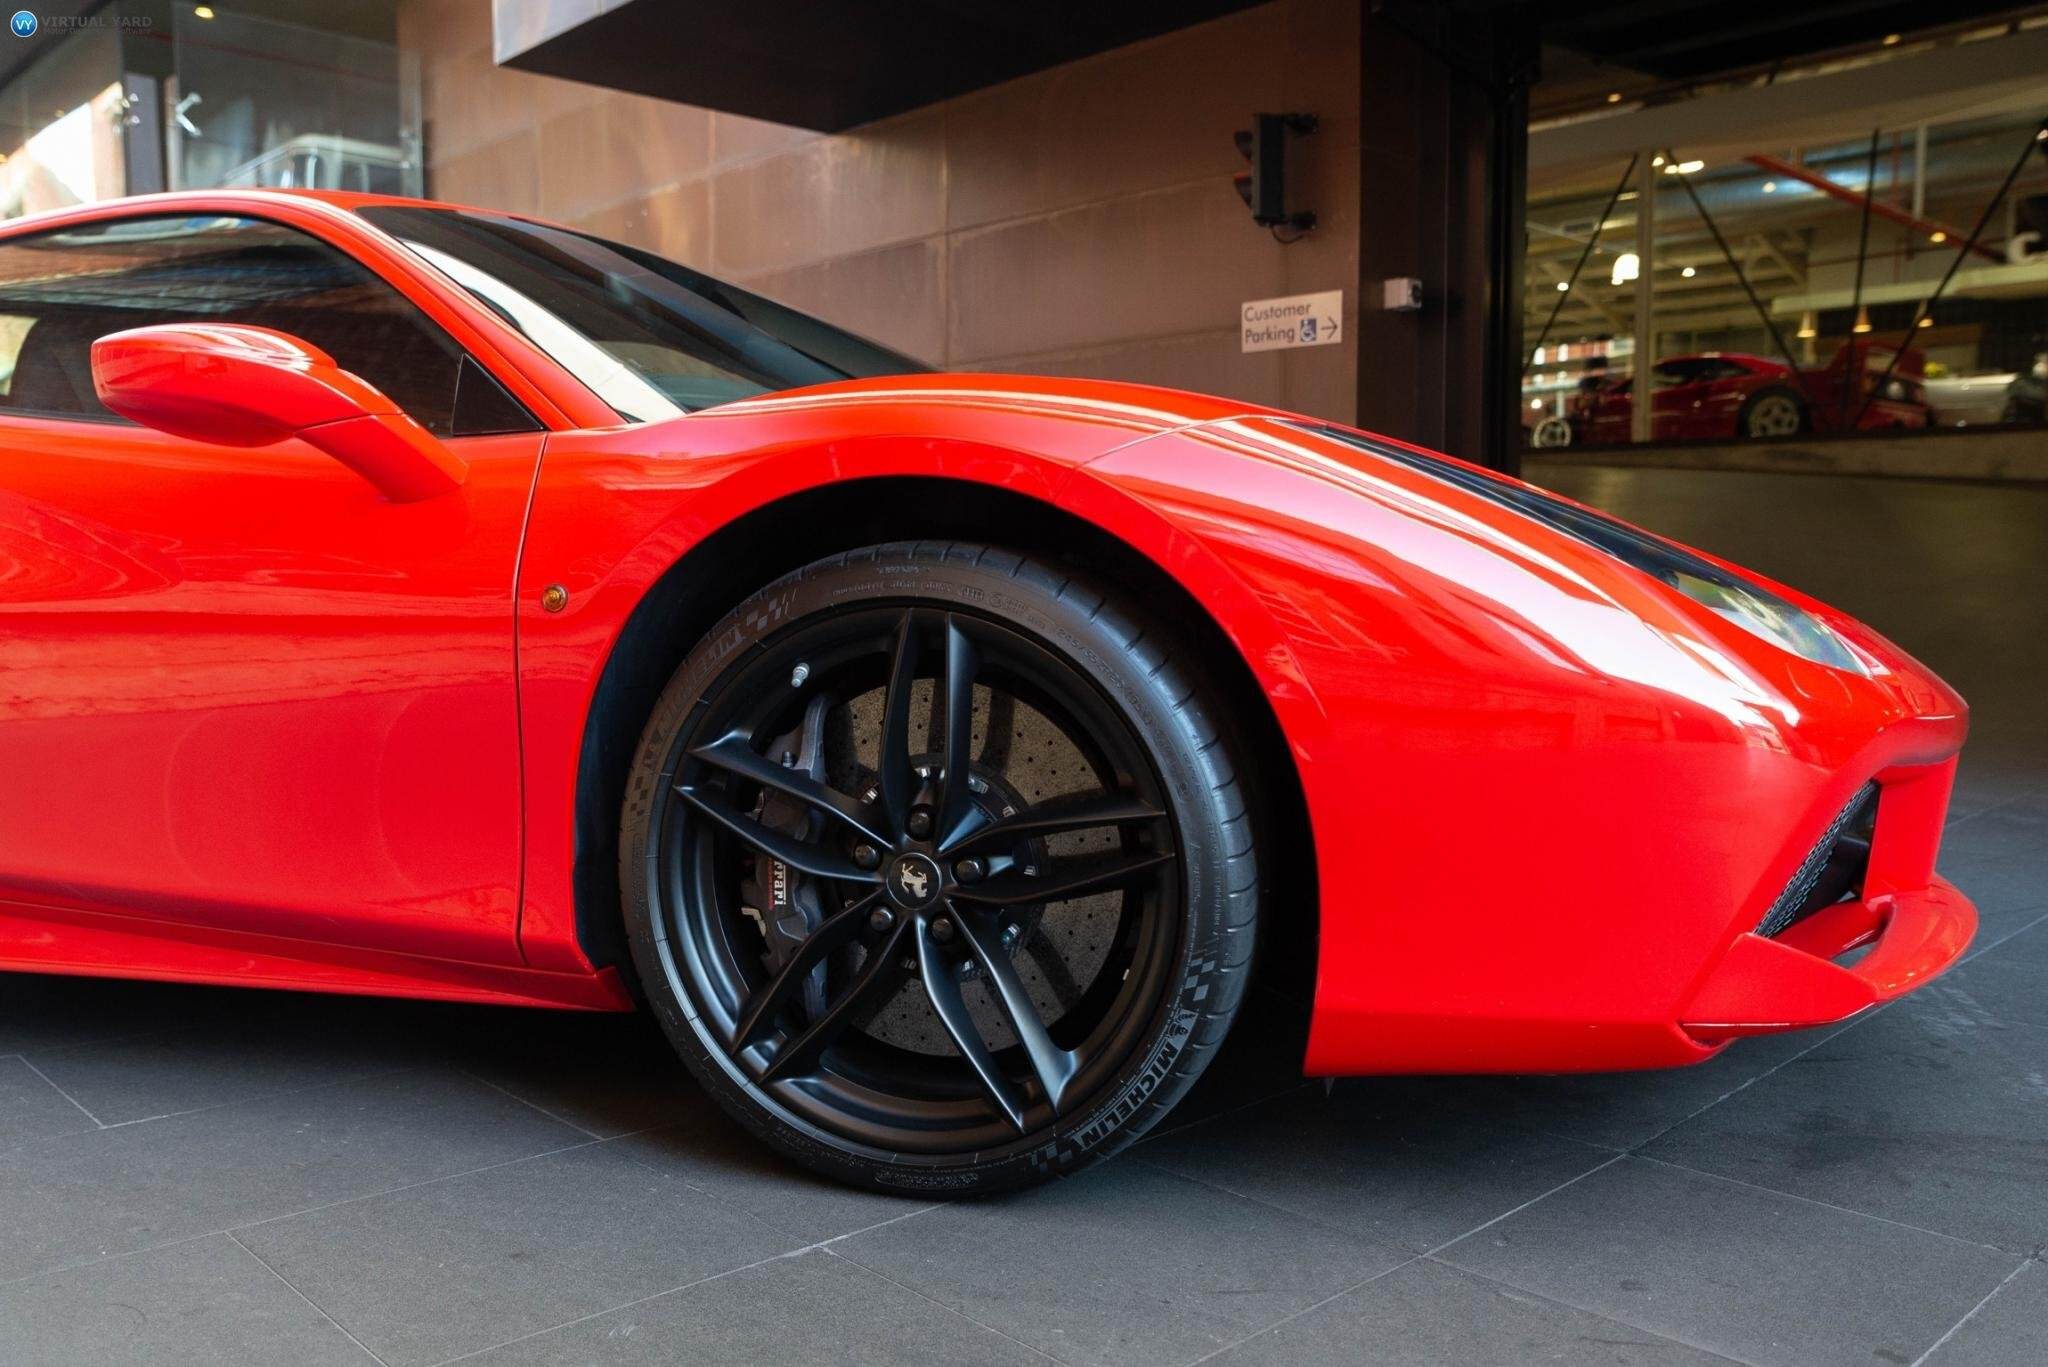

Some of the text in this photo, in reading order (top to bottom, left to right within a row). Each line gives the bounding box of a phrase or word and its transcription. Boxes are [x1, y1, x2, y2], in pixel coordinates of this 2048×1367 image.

[1244, 304, 1312, 322] Customer
[1245, 326, 1295, 344] Parking
[774, 861, 787, 905] rrari
[1079, 1038, 1179, 1149] MICHELIN
